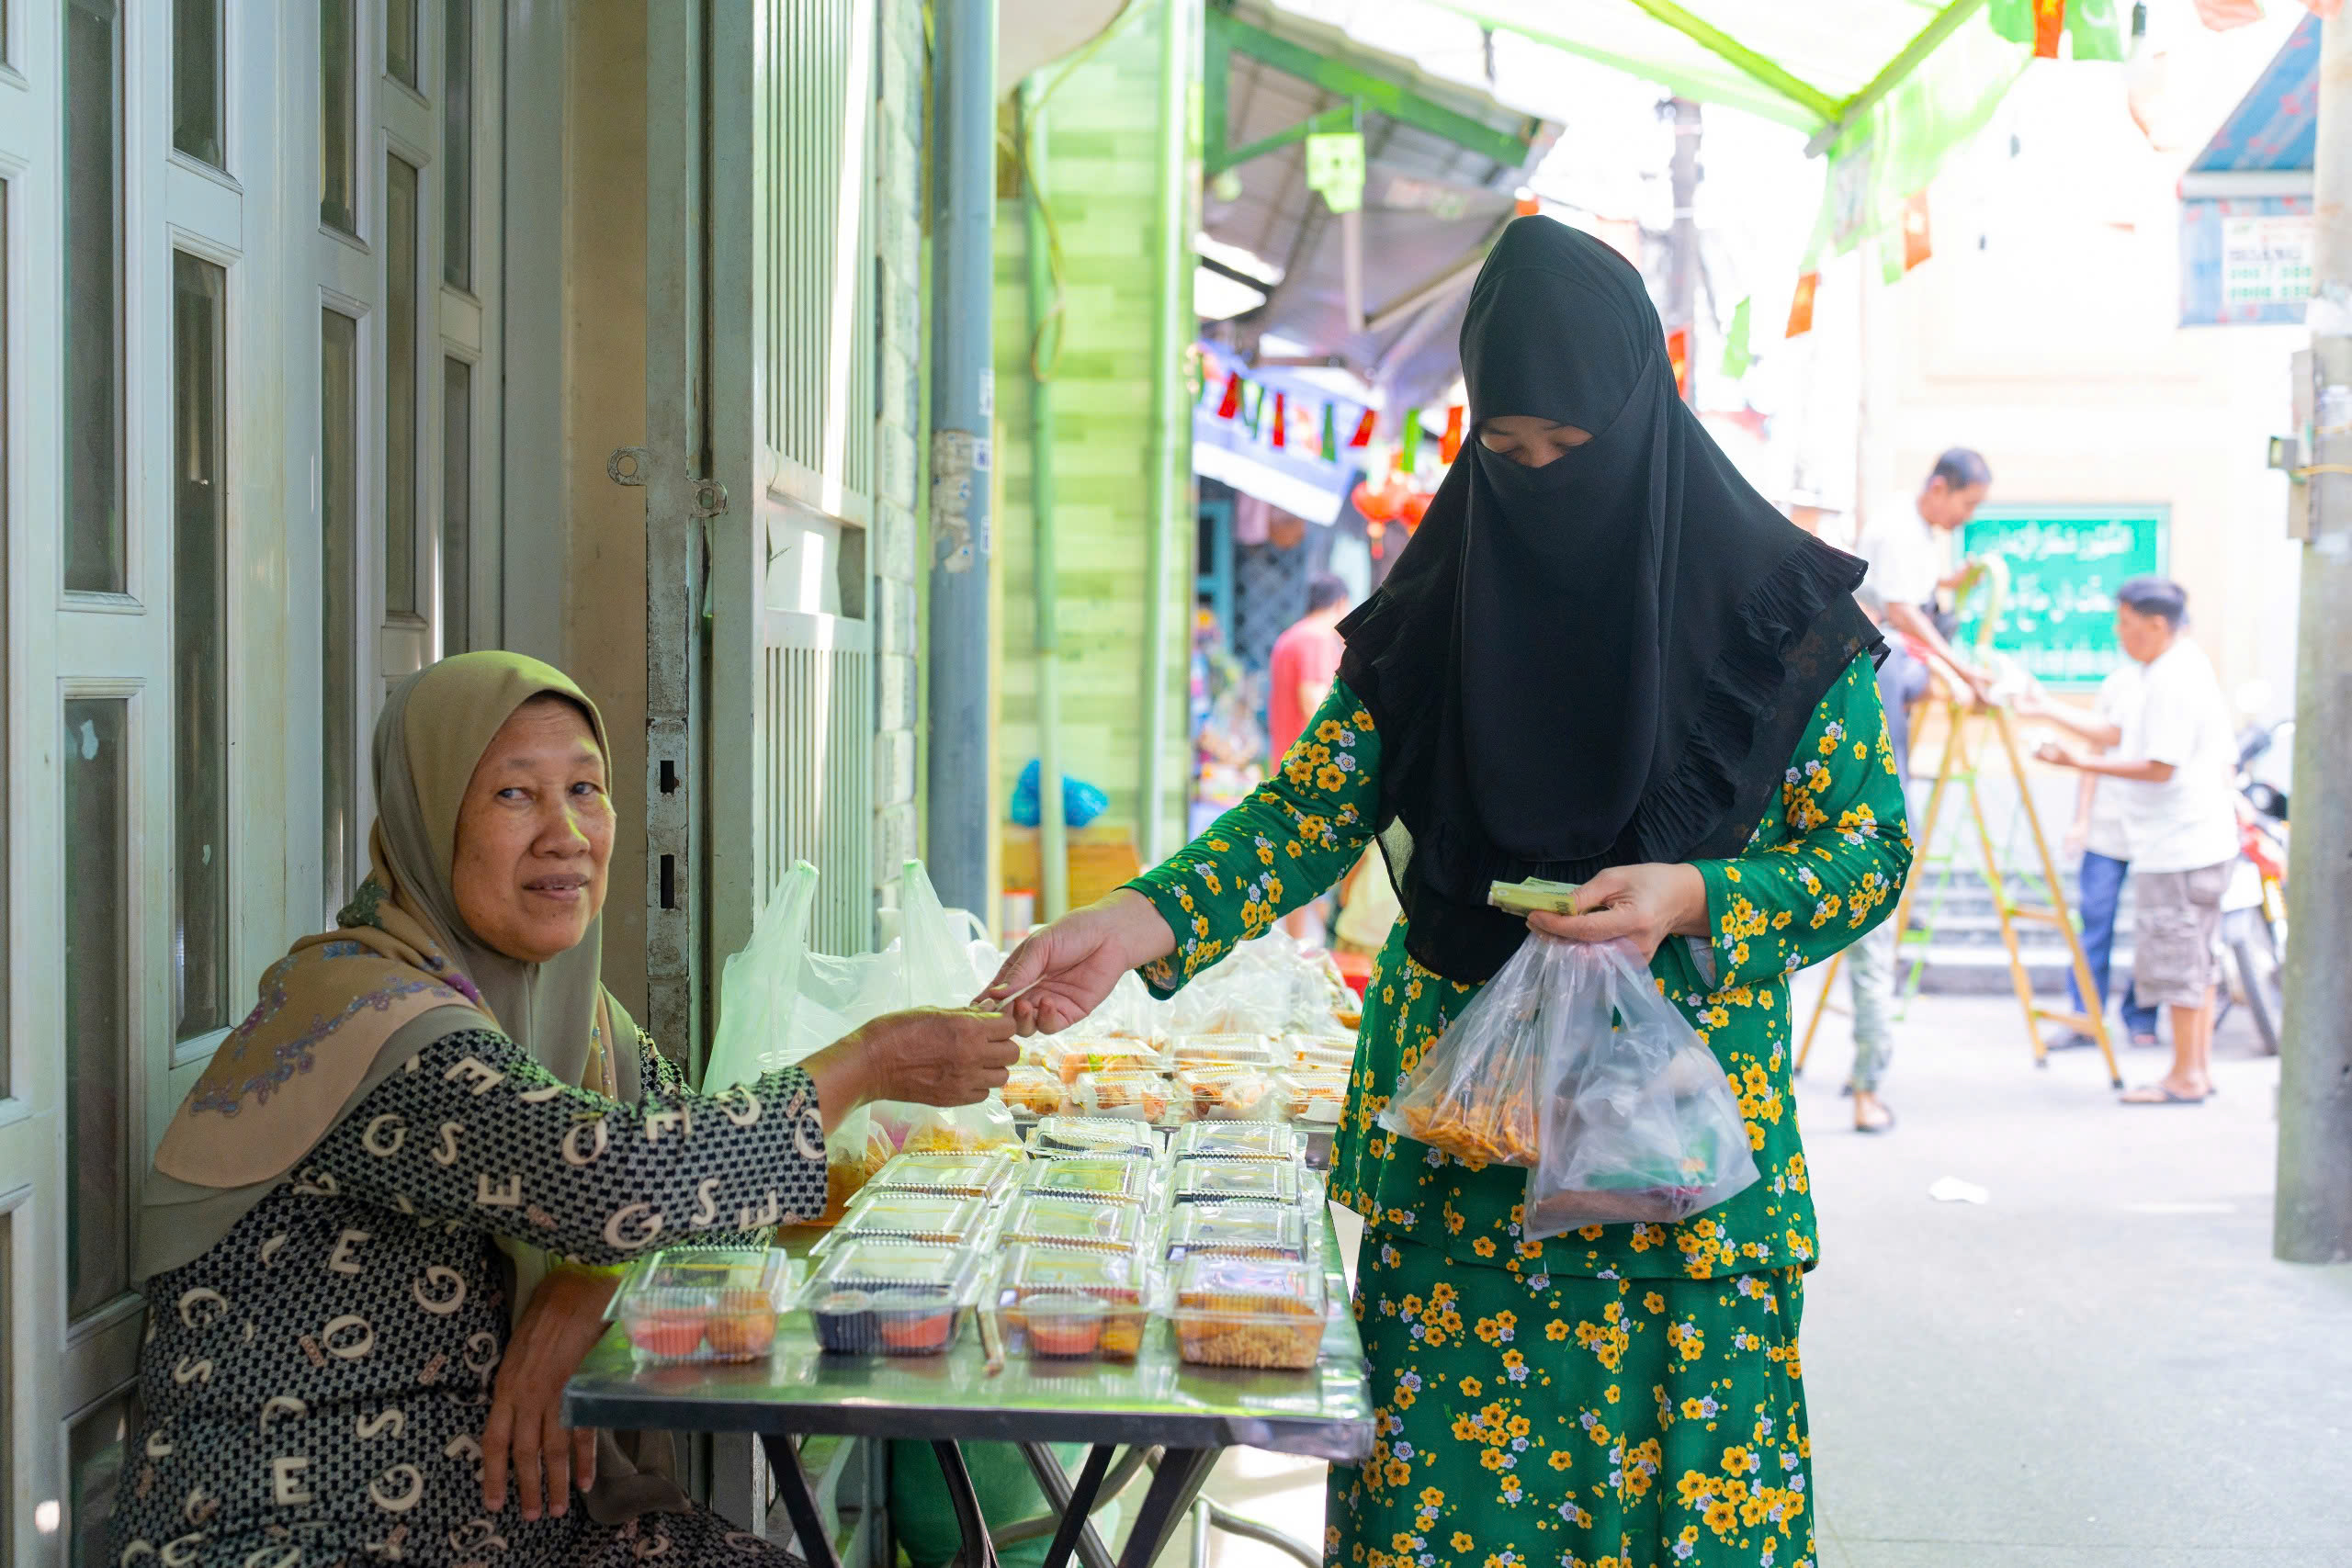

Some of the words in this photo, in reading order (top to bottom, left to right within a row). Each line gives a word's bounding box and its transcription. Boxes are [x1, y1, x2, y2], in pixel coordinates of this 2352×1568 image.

[443, 1055, 506, 1095] E
[362, 1113, 410, 1157] G
[431, 1121, 465, 1165] S
[476, 1174, 522, 1206] E
[691, 1178, 719, 1225] S
[739, 1190, 778, 1231] E
[603, 1202, 663, 1249] G
[329, 1228, 369, 1273] E
[413, 1265, 466, 1314] G
[322, 1314, 374, 1359] O
[174, 1355, 214, 1383] S
[356, 1408, 404, 1439] S
[276, 1457, 311, 1506] E
[368, 1462, 424, 1512] G
